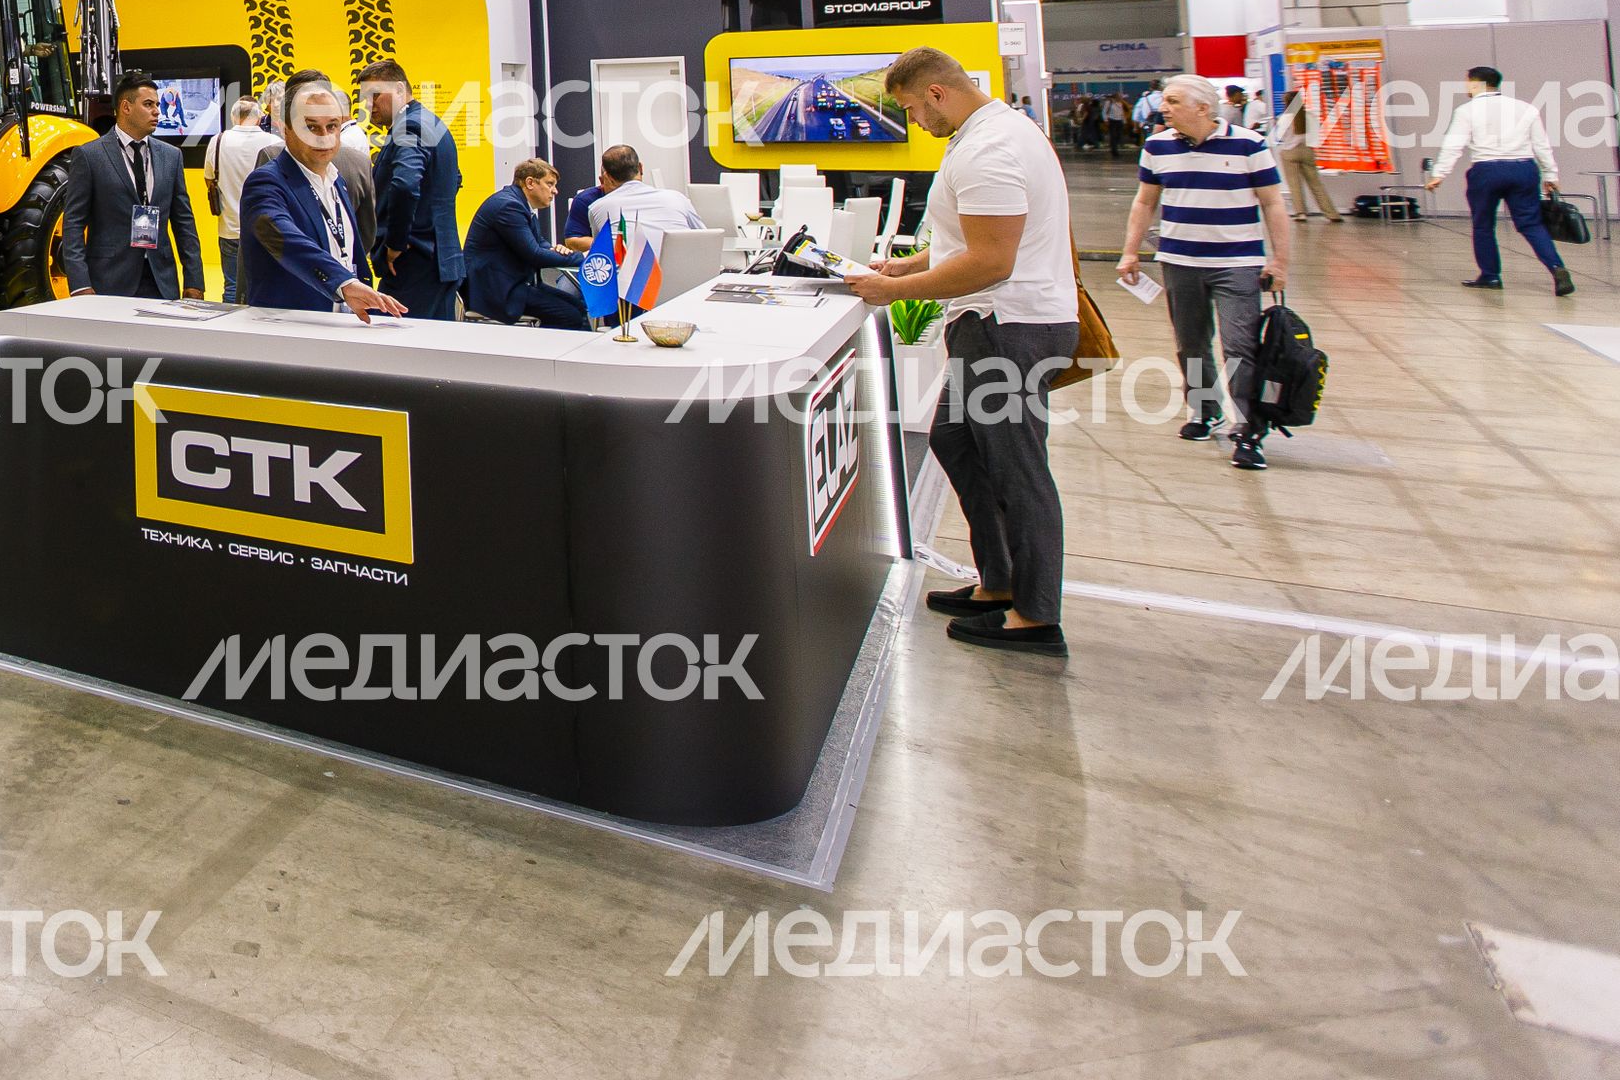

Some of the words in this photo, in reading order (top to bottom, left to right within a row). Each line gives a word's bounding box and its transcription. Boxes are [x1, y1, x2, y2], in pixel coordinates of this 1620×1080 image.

[824, 0, 932, 14] STCOM.GROUP
[1099, 42, 1149, 52] CHINA
[171, 430, 367, 513] СТК
[812, 373, 859, 524] ELAZ
[141, 527, 213, 552] ТЕХНИКА
[228, 542, 294, 566] СЕРВИС
[311, 556, 408, 587] ЗАПЧАСТИ
